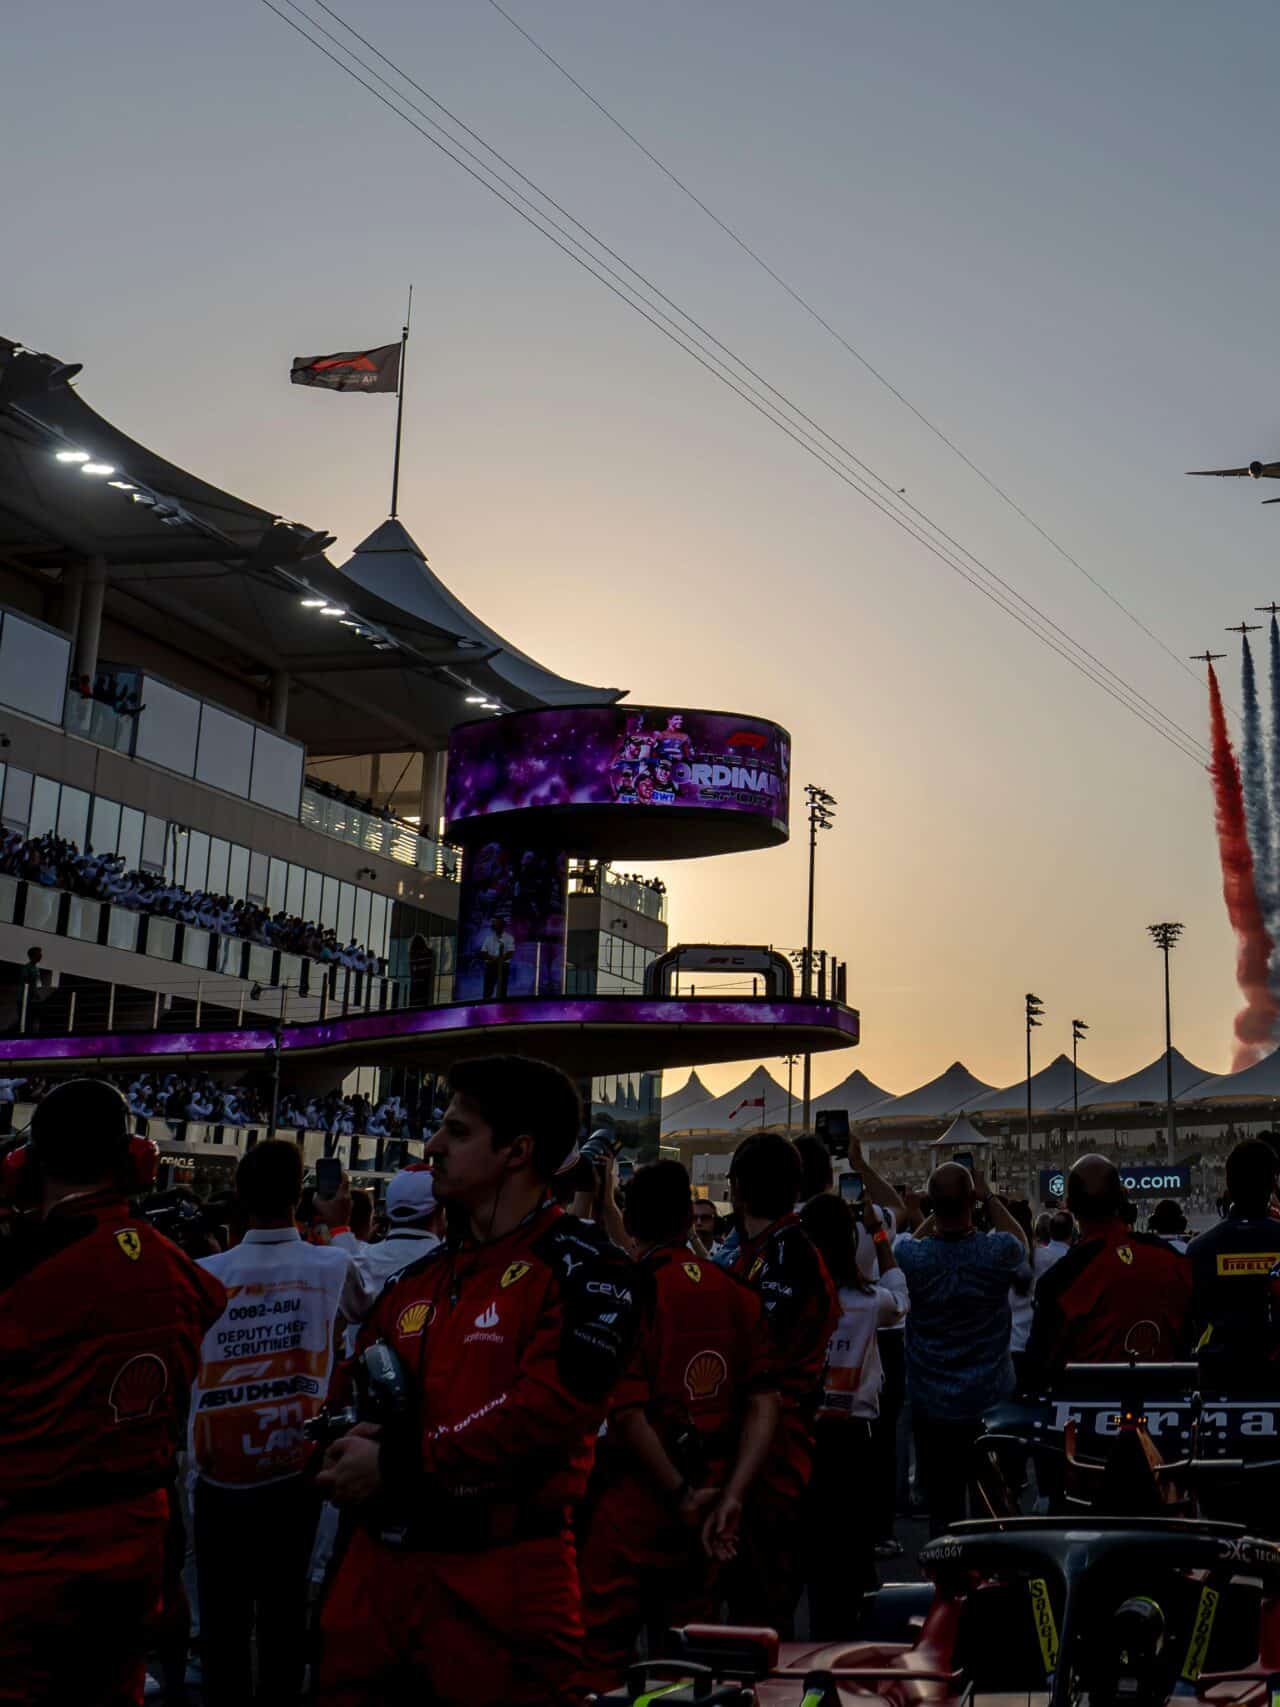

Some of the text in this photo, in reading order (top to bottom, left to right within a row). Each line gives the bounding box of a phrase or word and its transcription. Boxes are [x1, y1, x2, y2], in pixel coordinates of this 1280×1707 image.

[672, 762, 781, 793] ORDINA
[1223, 1256, 1276, 1270] PIRELL
[586, 1281, 632, 1304] CEVA
[229, 1298, 301, 1321] 0082-ABU
[217, 1326, 273, 1345] DEPUTY
